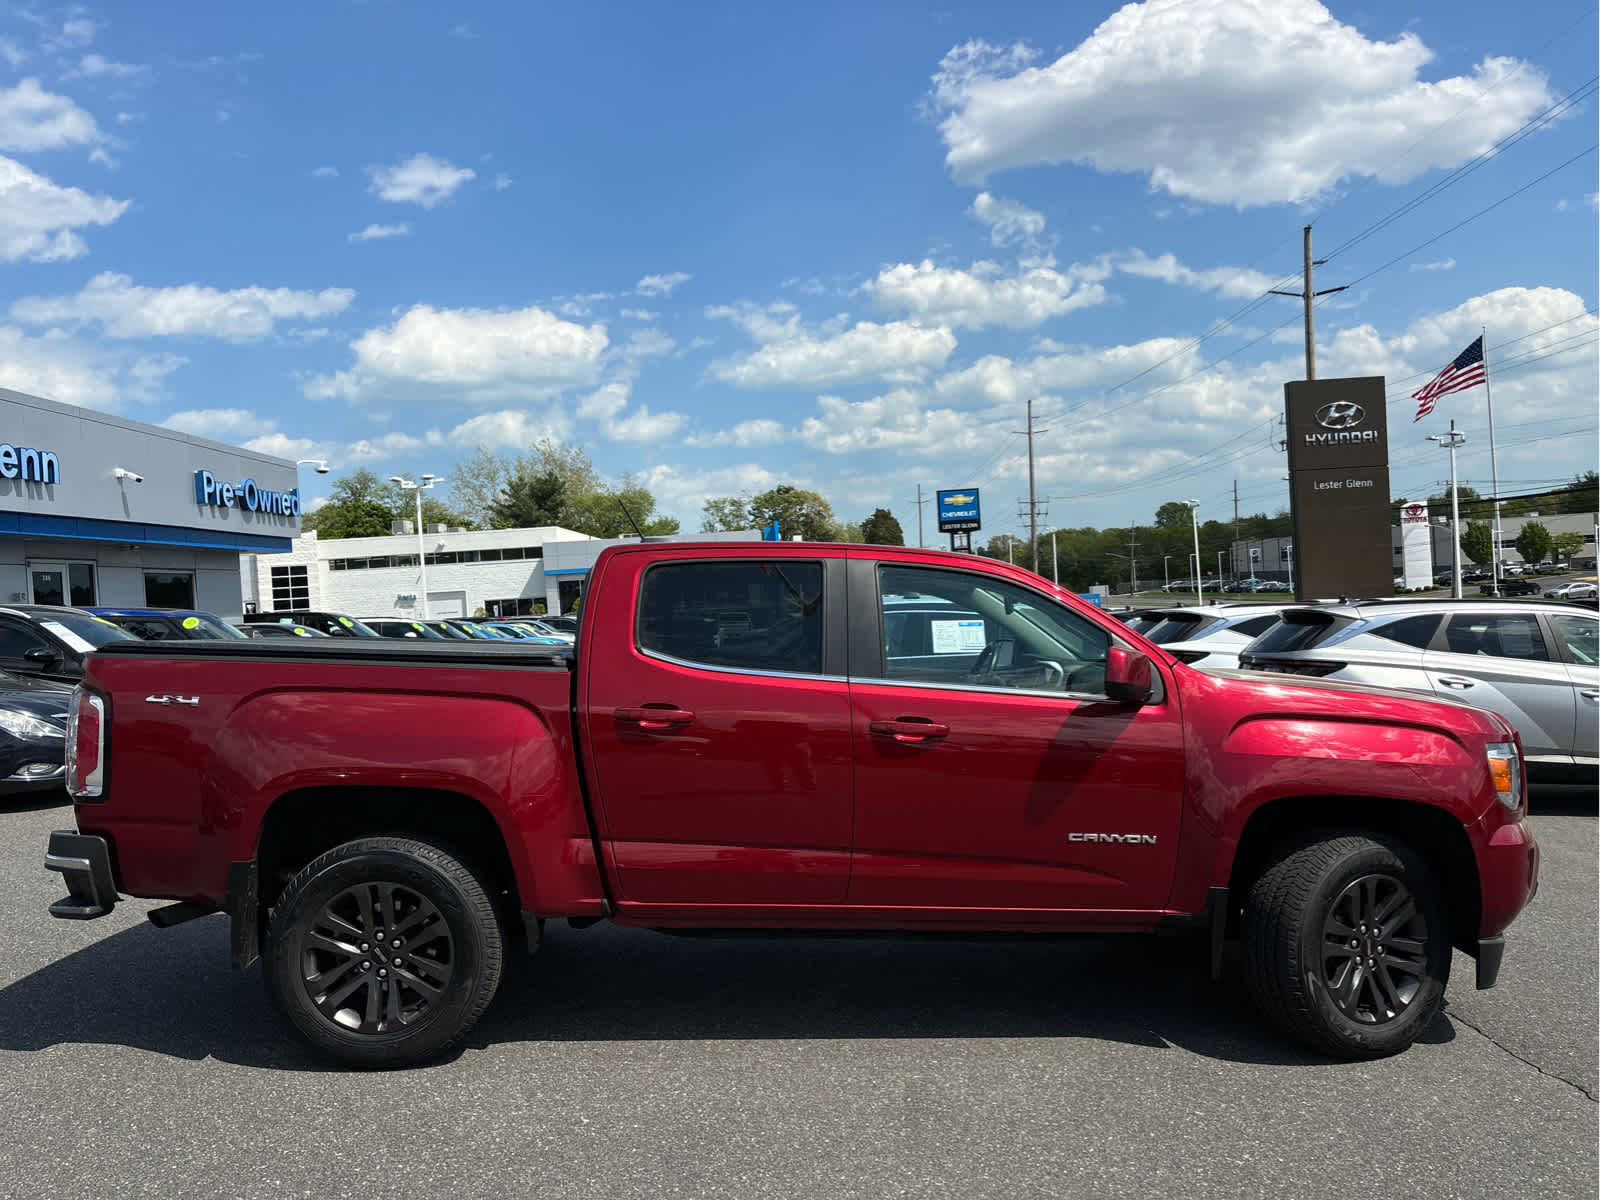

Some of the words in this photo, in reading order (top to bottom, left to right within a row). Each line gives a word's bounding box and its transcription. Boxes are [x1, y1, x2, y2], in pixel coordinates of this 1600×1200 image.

[1305, 431, 1377, 445] HYUNDAI
[1313, 480, 1344, 490] Lester
[1345, 479, 1373, 488] Glenn
[195, 469, 301, 517] Pre-Owned
[1068, 833, 1157, 844] CANYON
